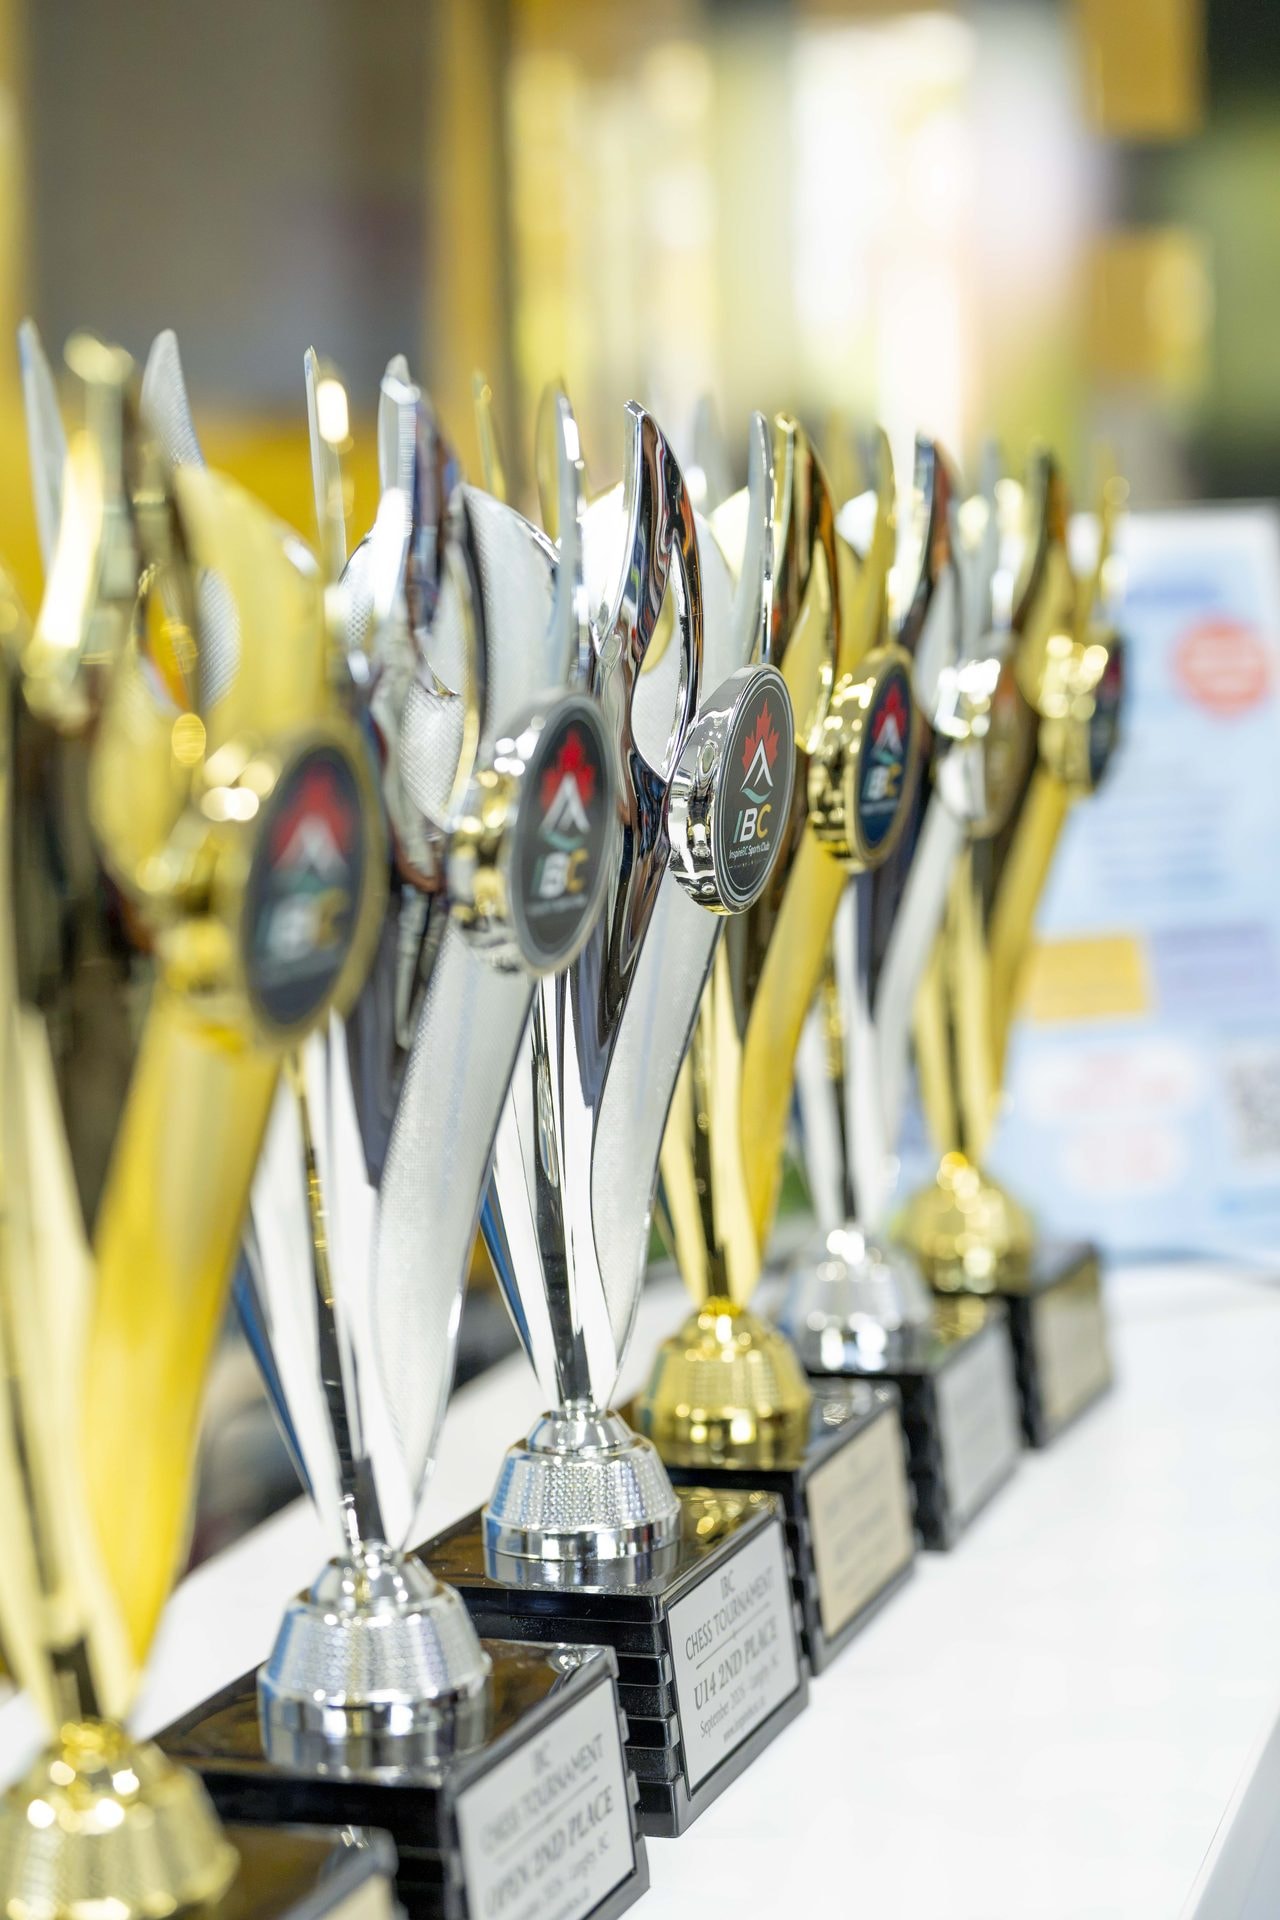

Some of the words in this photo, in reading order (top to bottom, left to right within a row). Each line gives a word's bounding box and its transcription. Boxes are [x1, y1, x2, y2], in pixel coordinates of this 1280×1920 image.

[733, 803, 772, 844] IBC
[760, 841, 770, 852] Club
[685, 1619, 713, 1661] CHESS
[713, 1566, 774, 1636] TOURNAMENT
[694, 1671, 717, 1711] U14
[718, 1647, 743, 1691] 2ND
[744, 1614, 777, 1665] PLACE
[700, 1701, 730, 1739] September
[568, 1785, 615, 1847] PLACE
